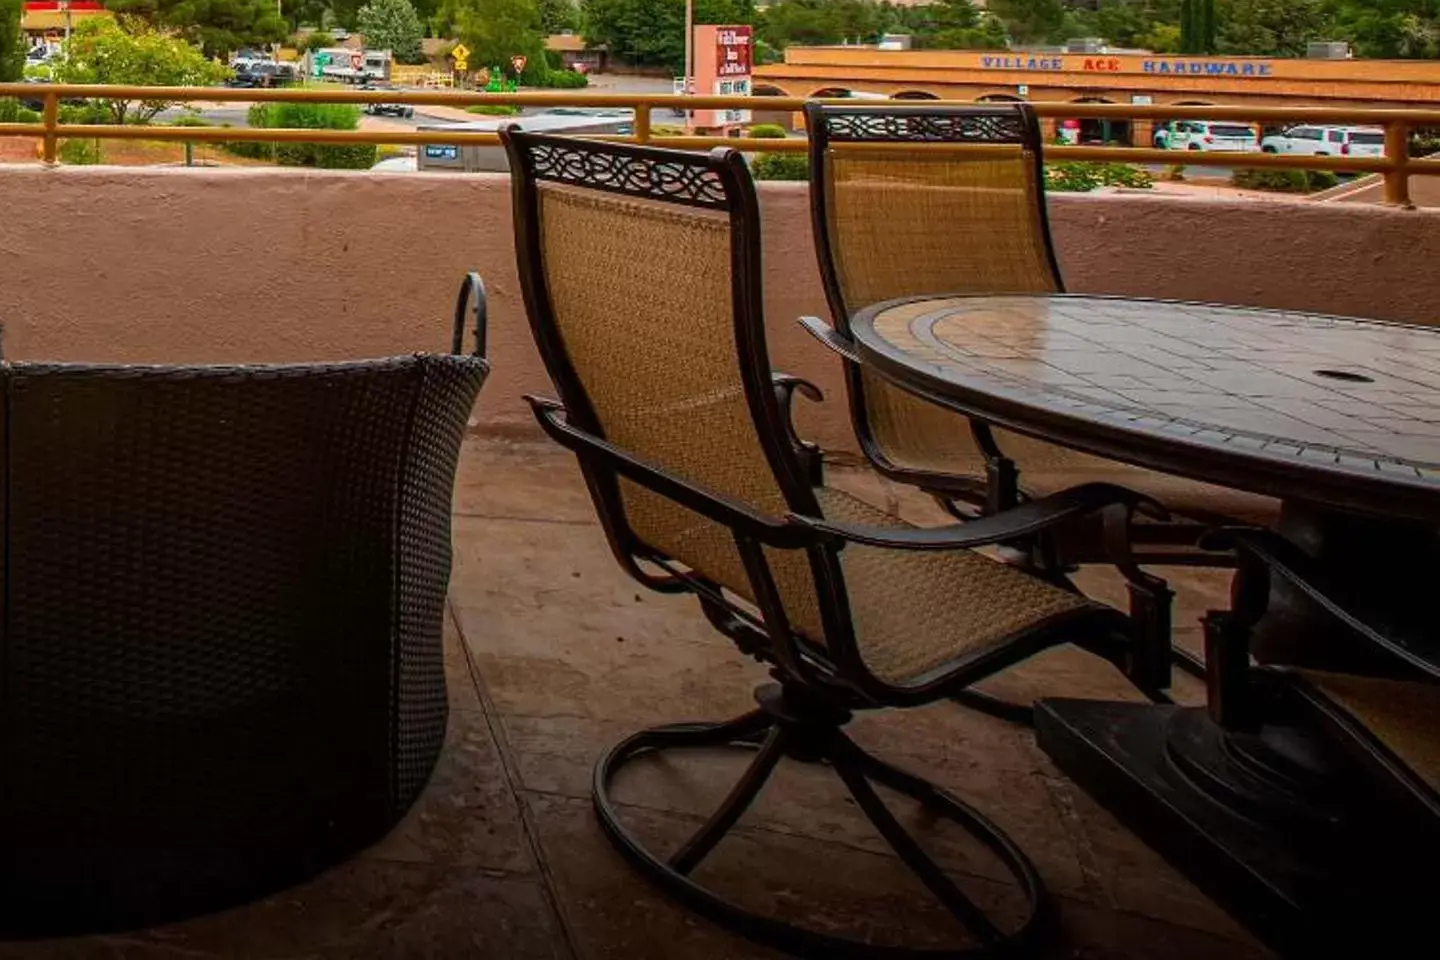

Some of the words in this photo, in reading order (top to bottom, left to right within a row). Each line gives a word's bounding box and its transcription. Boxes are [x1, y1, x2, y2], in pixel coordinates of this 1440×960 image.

[982, 55, 1063, 70] VILLAGE
[1083, 57, 1120, 71] ACE
[1143, 60, 1273, 76] HARDWARE
